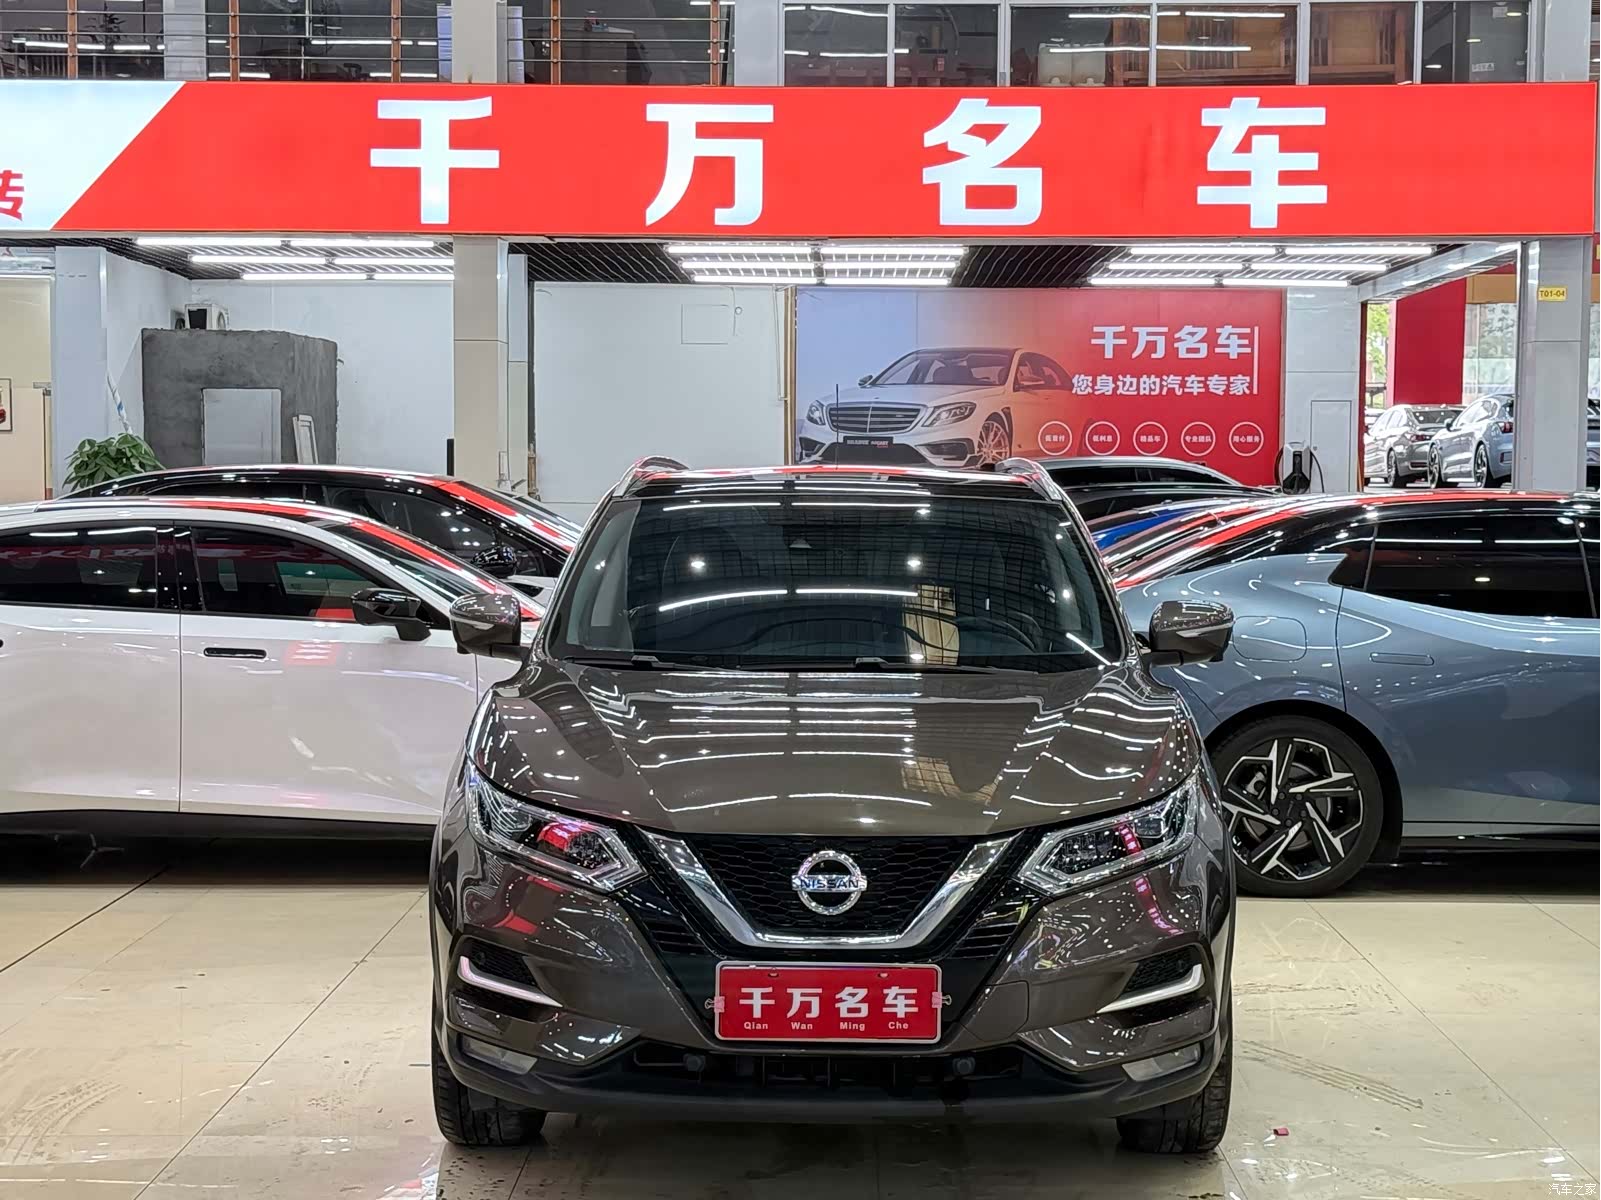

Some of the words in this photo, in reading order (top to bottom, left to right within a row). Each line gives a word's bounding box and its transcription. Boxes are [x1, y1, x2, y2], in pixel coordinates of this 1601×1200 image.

[370, 97, 1328, 228] 千万名车
[1090, 325, 1252, 359] 千万名车
[1072, 374, 1251, 396] 您身边的汽车专家
[1184, 435, 1212, 443] 专业团队
[800, 879, 859, 889] NISSAN
[739, 986, 919, 1019] 千万名车
[743, 1021, 769, 1030] Qian
[791, 1021, 813, 1030] Wan
[839, 1021, 866, 1031] Ming
[888, 1021, 909, 1029] Che
